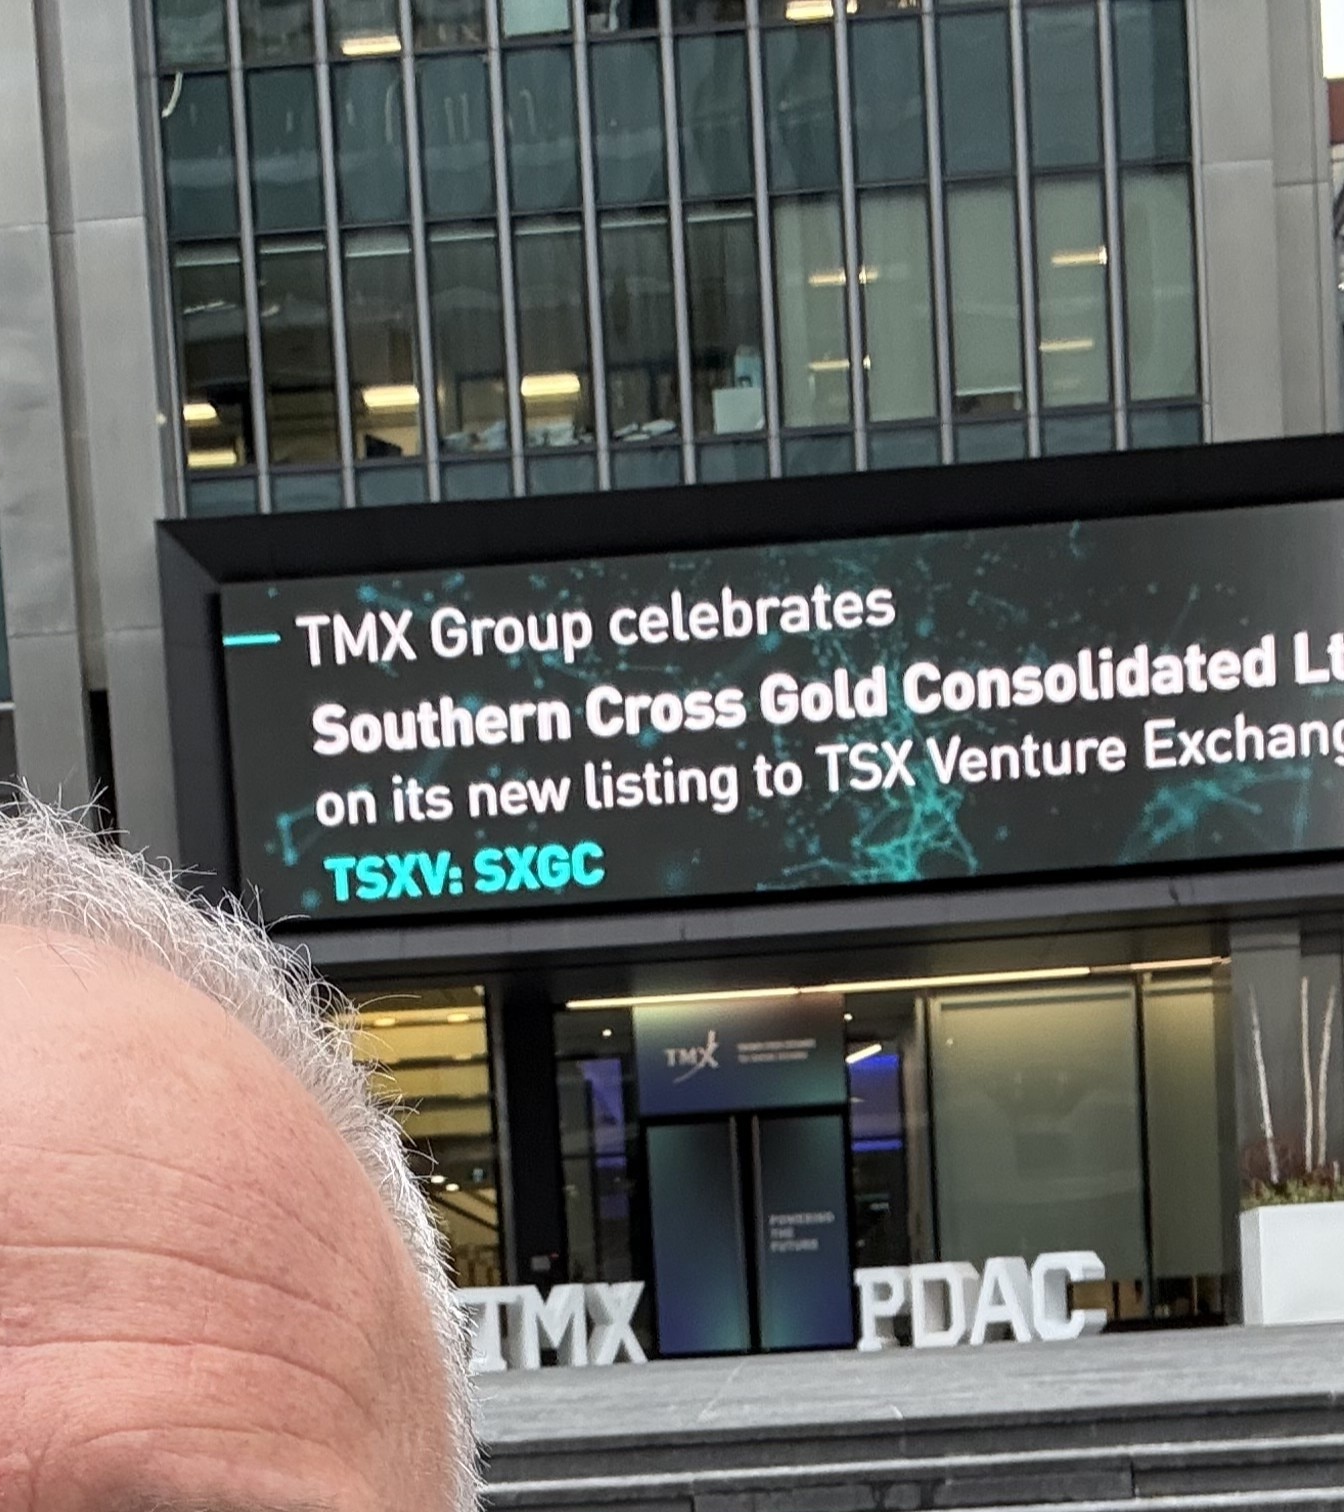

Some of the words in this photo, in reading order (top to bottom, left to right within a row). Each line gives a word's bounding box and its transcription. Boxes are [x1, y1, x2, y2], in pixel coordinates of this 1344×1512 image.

[296, 609, 416, 666] TMX
[431, 607, 592, 663] Group
[608, 584, 895, 645] celebrates
[313, 696, 571, 755] Southern
[586, 685, 746, 737] Cross
[760, 665, 887, 724] Gold
[903, 634, 1276, 713] Consolidated
[316, 790, 376, 826] on
[392, 775, 453, 822] its
[469, 777, 570, 817] new
[585, 757, 738, 813] listing
[753, 755, 802, 797] to
[815, 739, 915, 792] TSX
[926, 735, 1126, 784] Venture
[324, 851, 462, 901] TSXV:
[474, 842, 604, 892] SXGC
[664, 1030, 719, 1083] TMX
[457, 1281, 649, 1371] TMX
[854, 1250, 1108, 1352] PDAC
